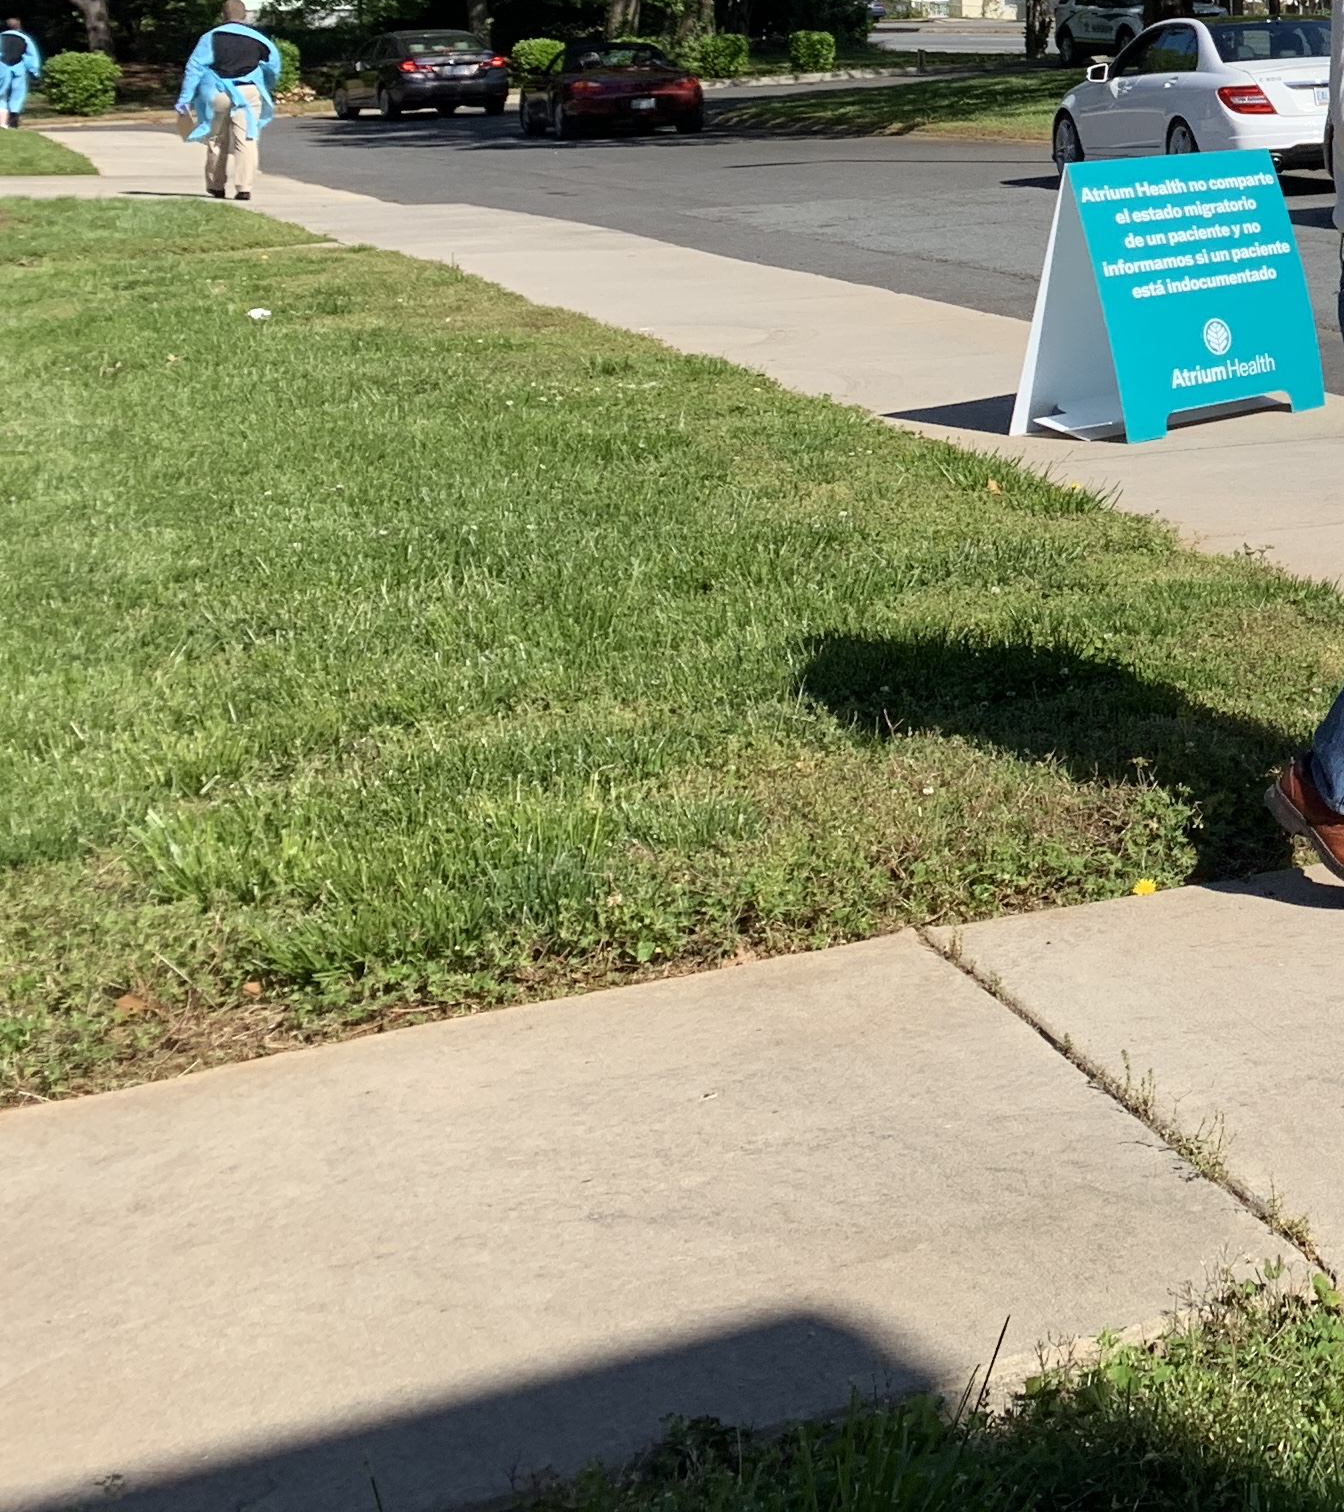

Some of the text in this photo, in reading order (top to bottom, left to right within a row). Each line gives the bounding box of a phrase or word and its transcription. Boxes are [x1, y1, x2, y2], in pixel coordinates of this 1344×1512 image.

[1081, 171, 1274, 203] Atrium Health no comparte
[1115, 195, 1257, 224] el estado migratorio
[1124, 222, 1261, 248] de un paciente y no
[1102, 240, 1291, 277] informamos si un paciente
[1131, 264, 1277, 299] está indocumentado
